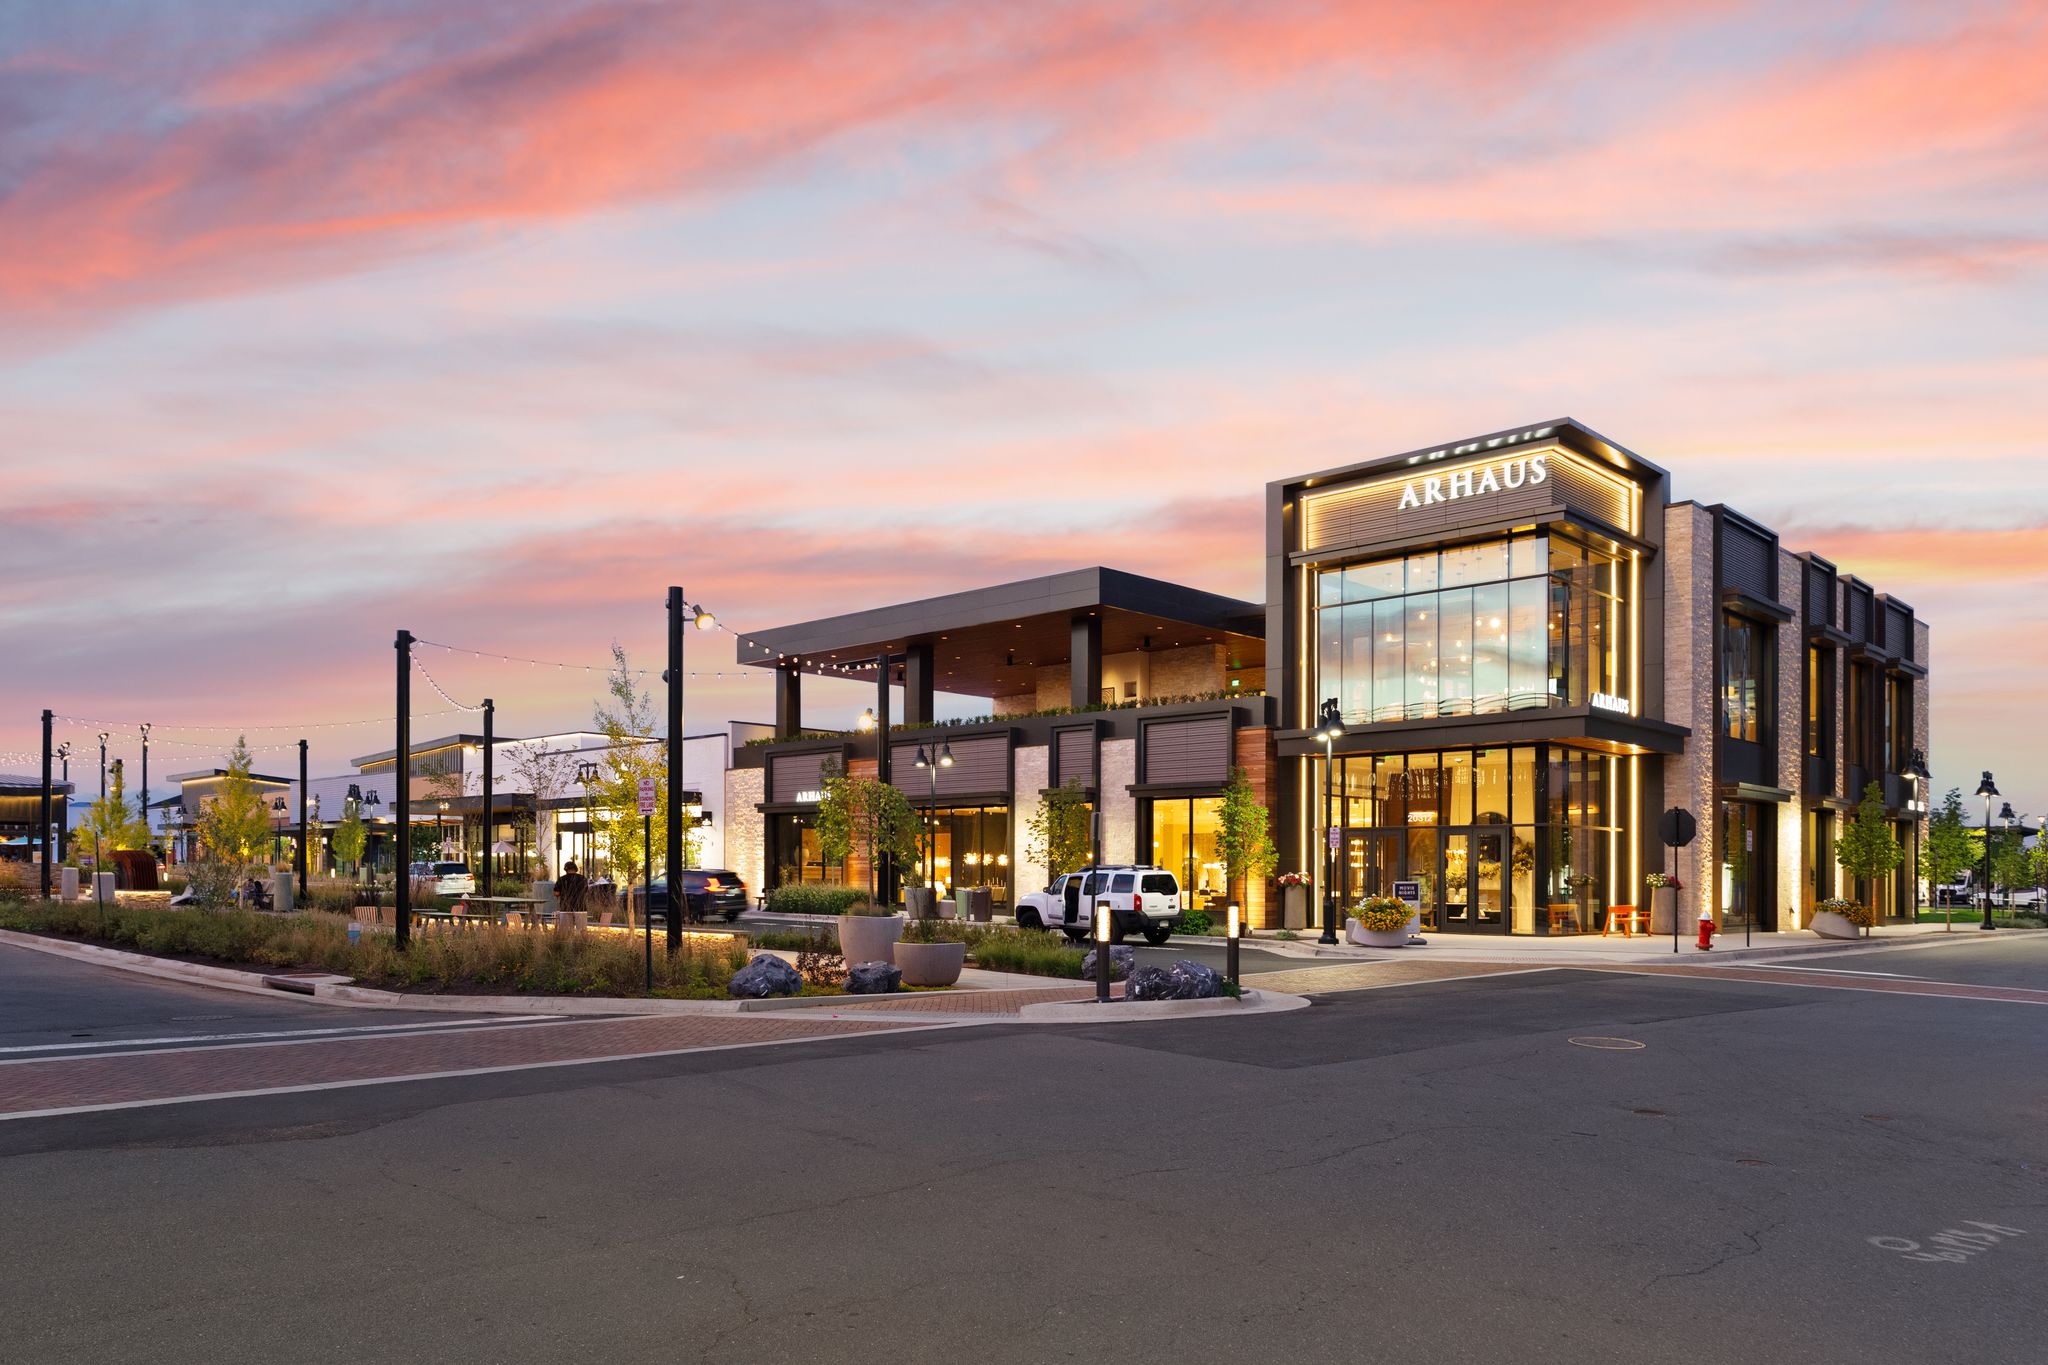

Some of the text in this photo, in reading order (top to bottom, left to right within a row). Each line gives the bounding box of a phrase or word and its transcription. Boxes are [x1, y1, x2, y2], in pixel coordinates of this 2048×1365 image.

[1397, 455, 1547, 510] ARHAUS
[1591, 692, 1629, 714] ARHAUS
[1407, 814, 1433, 822] 20312
